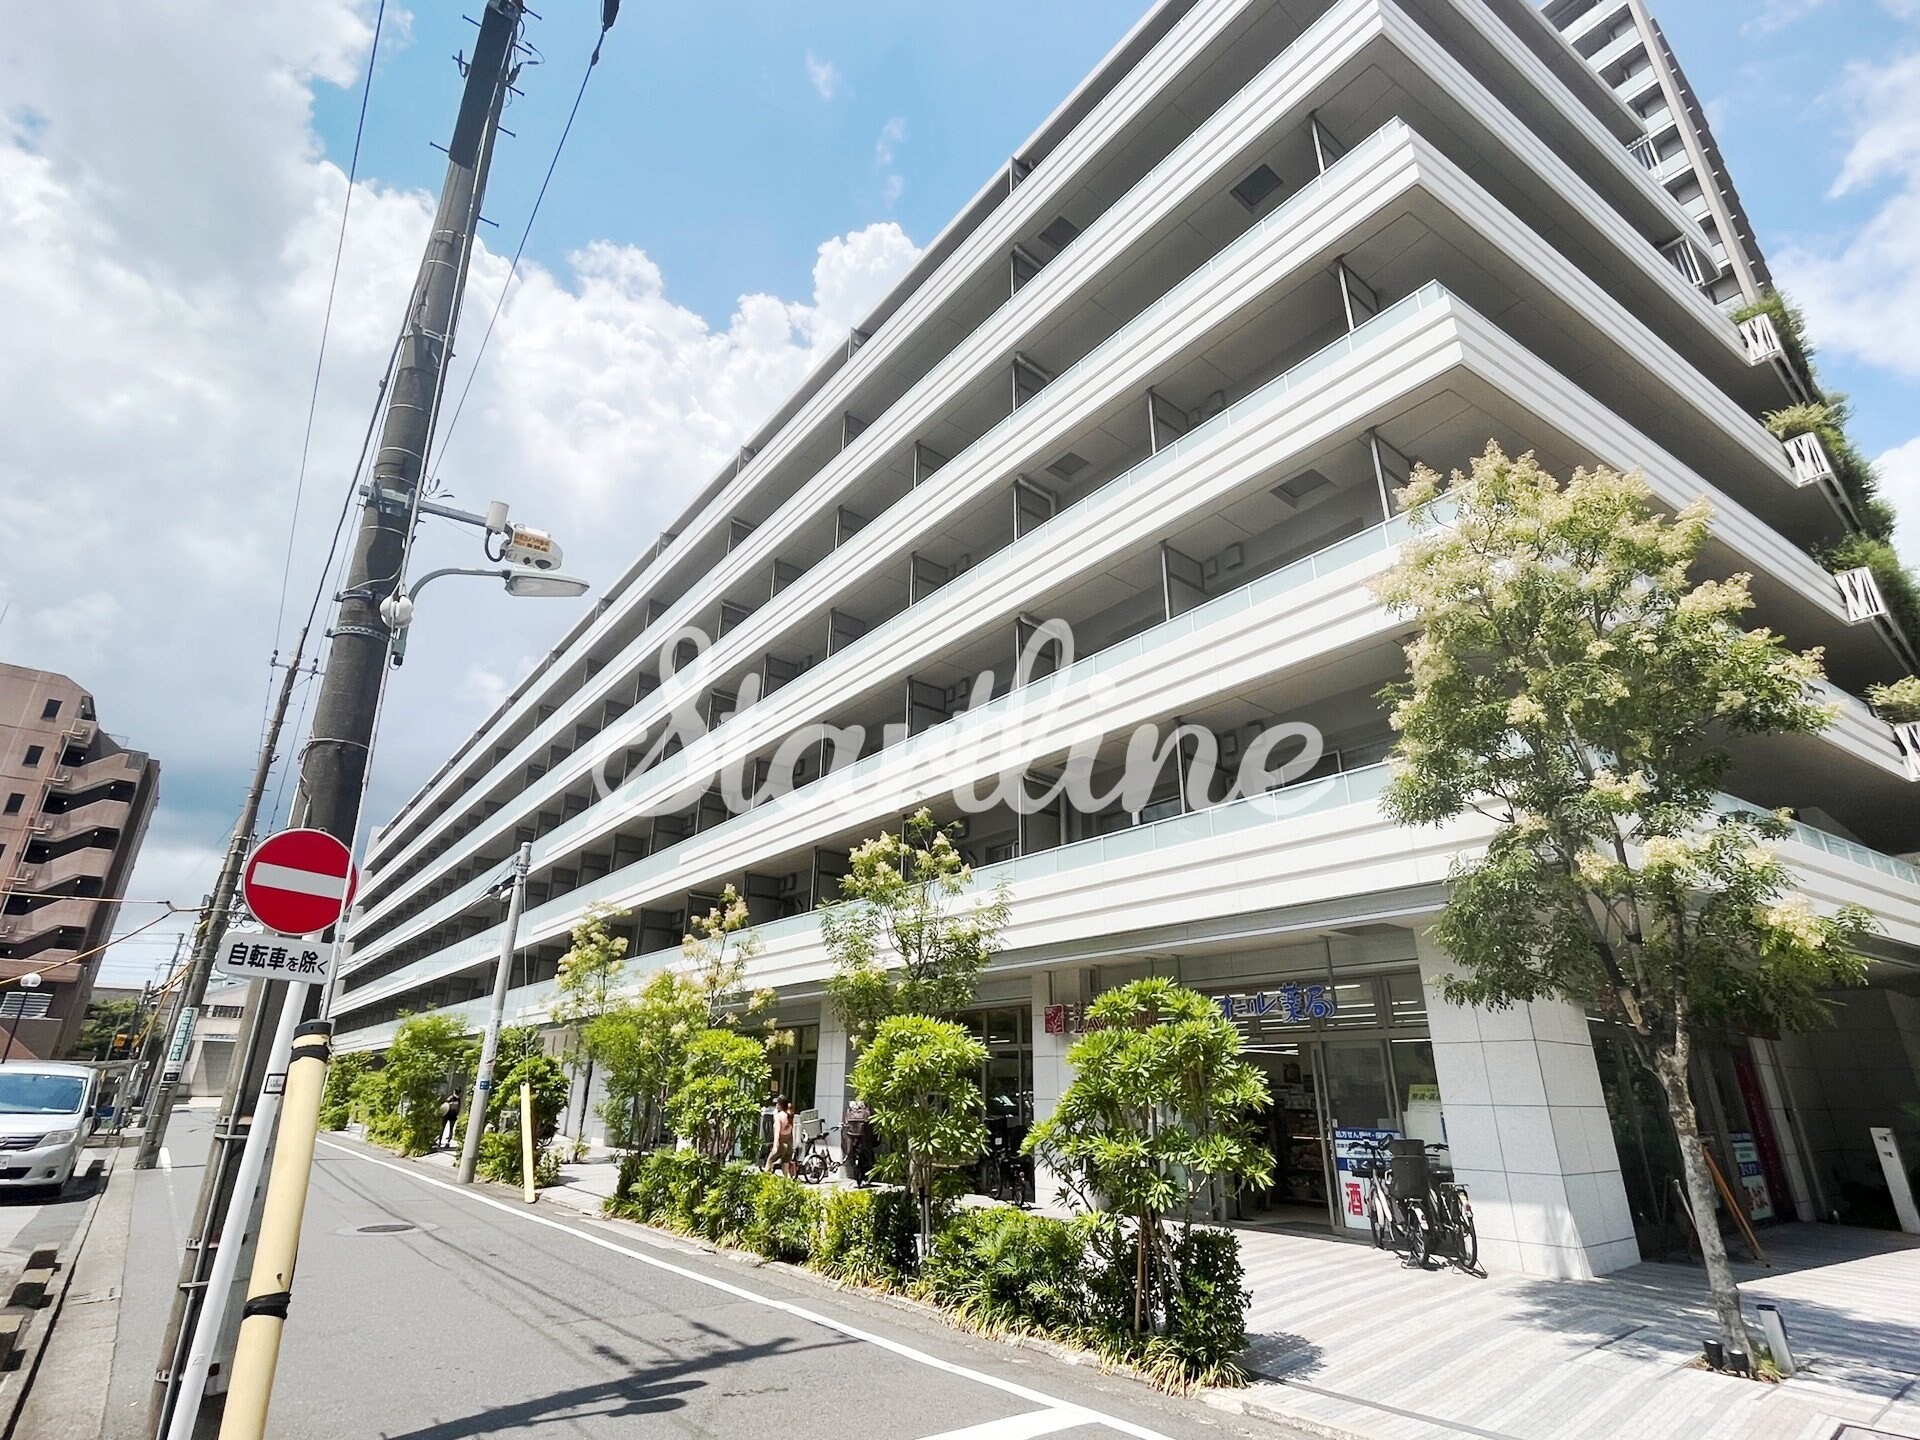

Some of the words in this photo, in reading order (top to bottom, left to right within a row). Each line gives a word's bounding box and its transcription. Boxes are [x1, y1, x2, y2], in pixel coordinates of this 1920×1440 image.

[227, 942, 328, 975] 自転車を除く
[1220, 982, 1336, 1023] オール薬局
[1346, 1183, 1363, 1216] 酒
